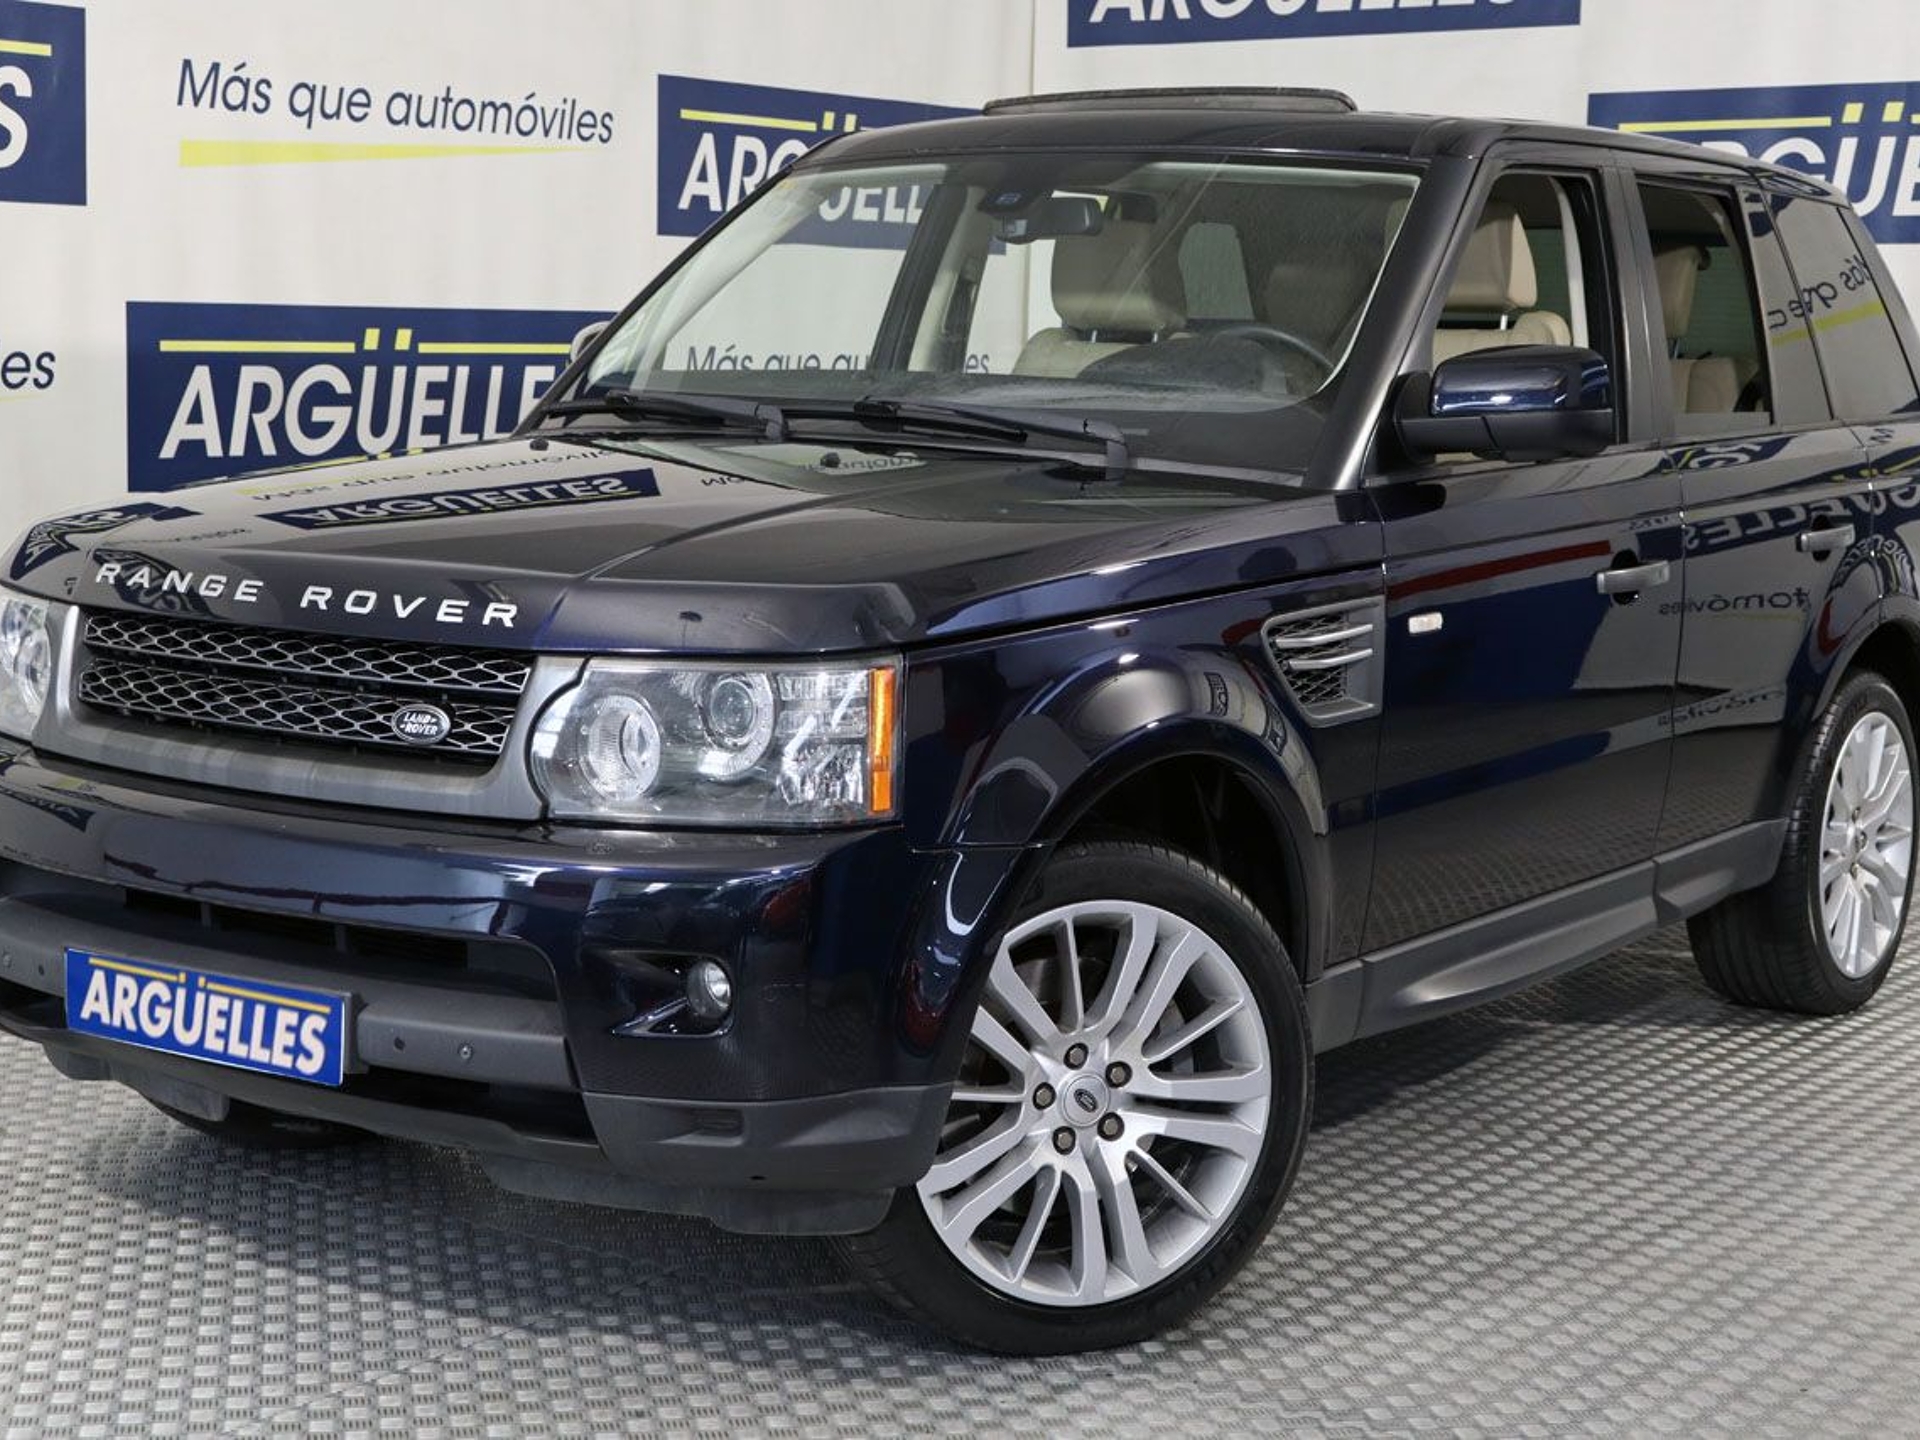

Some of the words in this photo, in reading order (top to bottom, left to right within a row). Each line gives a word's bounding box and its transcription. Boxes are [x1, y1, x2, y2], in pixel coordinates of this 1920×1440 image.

[176, 58, 272, 114] Más
[288, 80, 372, 129] que
[385, 86, 614, 143] automóviles
[158, 328, 556, 459] ARGÜELLE
[96, 563, 264, 602] RANGE
[301, 585, 518, 627] ROVER
[80, 969, 327, 1076] ARGÜELLES
